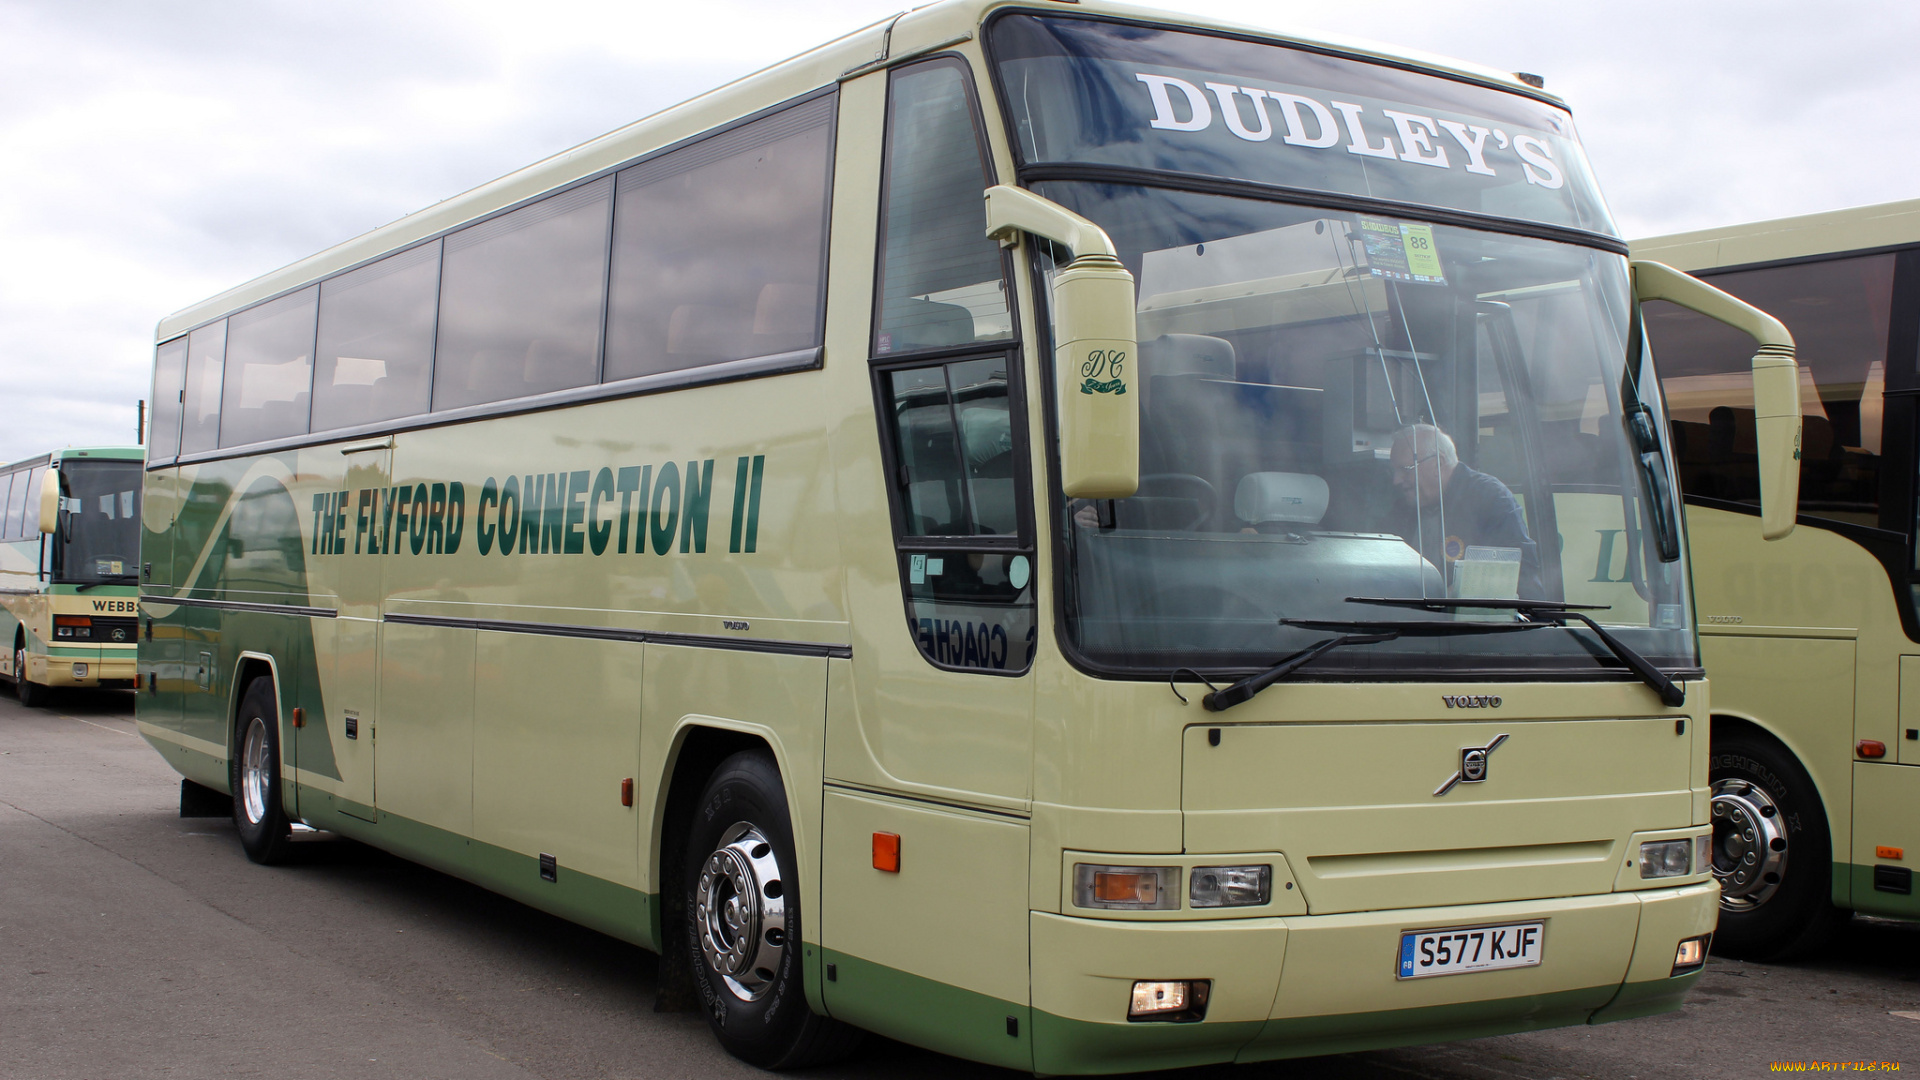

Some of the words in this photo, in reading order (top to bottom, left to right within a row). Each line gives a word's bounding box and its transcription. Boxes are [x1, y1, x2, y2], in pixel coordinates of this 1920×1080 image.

[1135, 73, 1564, 190] DUDLEY'S
[1410, 236, 1429, 250] 88
[312, 490, 349, 556] THE
[354, 481, 465, 556] FLYFORD
[477, 459, 715, 557] CONNECTION
[729, 455, 766, 554] II
[1707, 615, 1743, 625] VOLVO
[1442, 695, 1503, 709] VOLVO
[1710, 754, 1787, 799] ICHELIN
[1420, 932, 1485, 967] S577
[1490, 927, 1538, 961] KJF
[1403, 960, 1413, 969] GB
